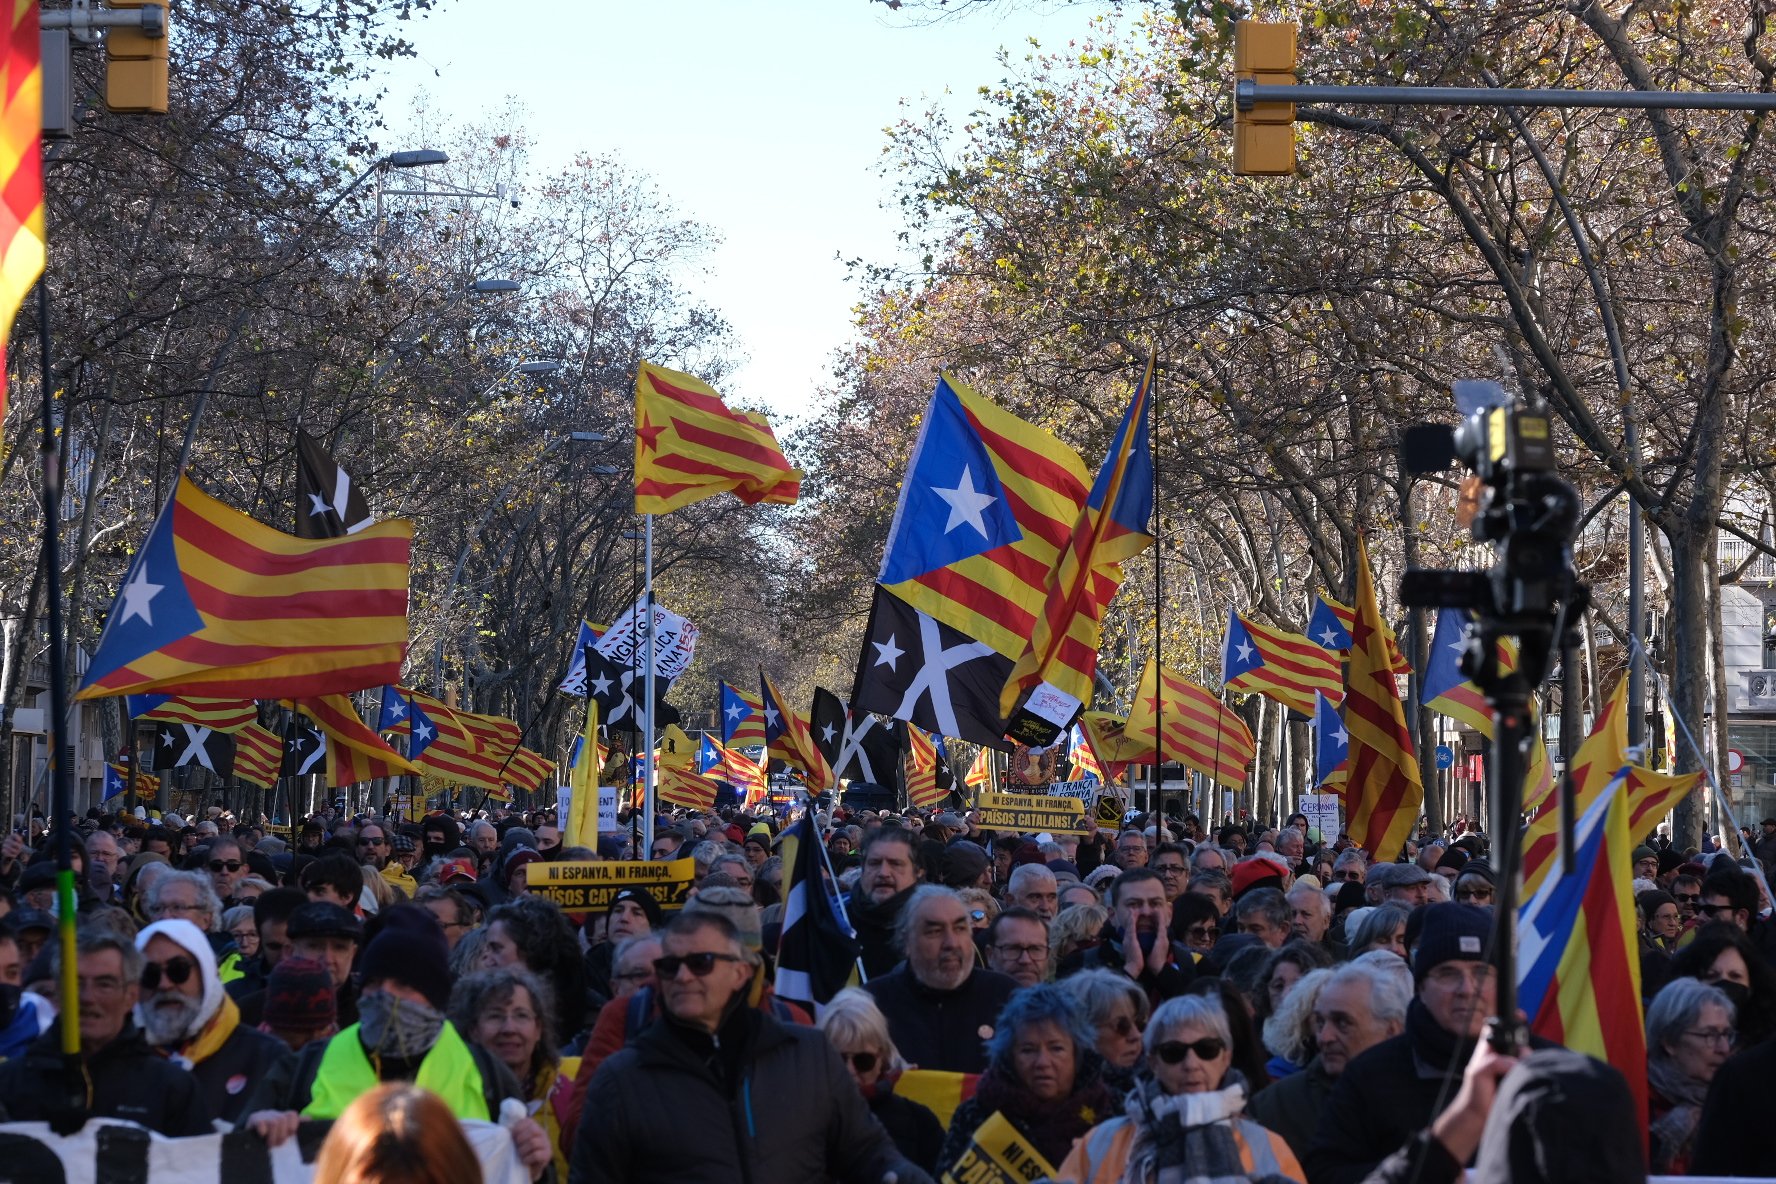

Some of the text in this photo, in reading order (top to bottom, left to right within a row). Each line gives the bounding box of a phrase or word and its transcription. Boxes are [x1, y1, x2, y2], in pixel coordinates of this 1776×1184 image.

[1050, 783, 1059, 793] NI
[1062, 779, 1093, 792] FRANÇA
[992, 796, 1000, 805] NI
[1001, 797, 1034, 809] ESPANYA,
[1035, 799, 1043, 808] NI
[980, 808, 1071, 828] PAÏSOS CATALANS!
[548, 867, 559, 880] NI
[562, 867, 612, 881] ESPANYA,
[615, 866, 626, 879] NI
[1001, 1141, 1048, 1182] NI ES
